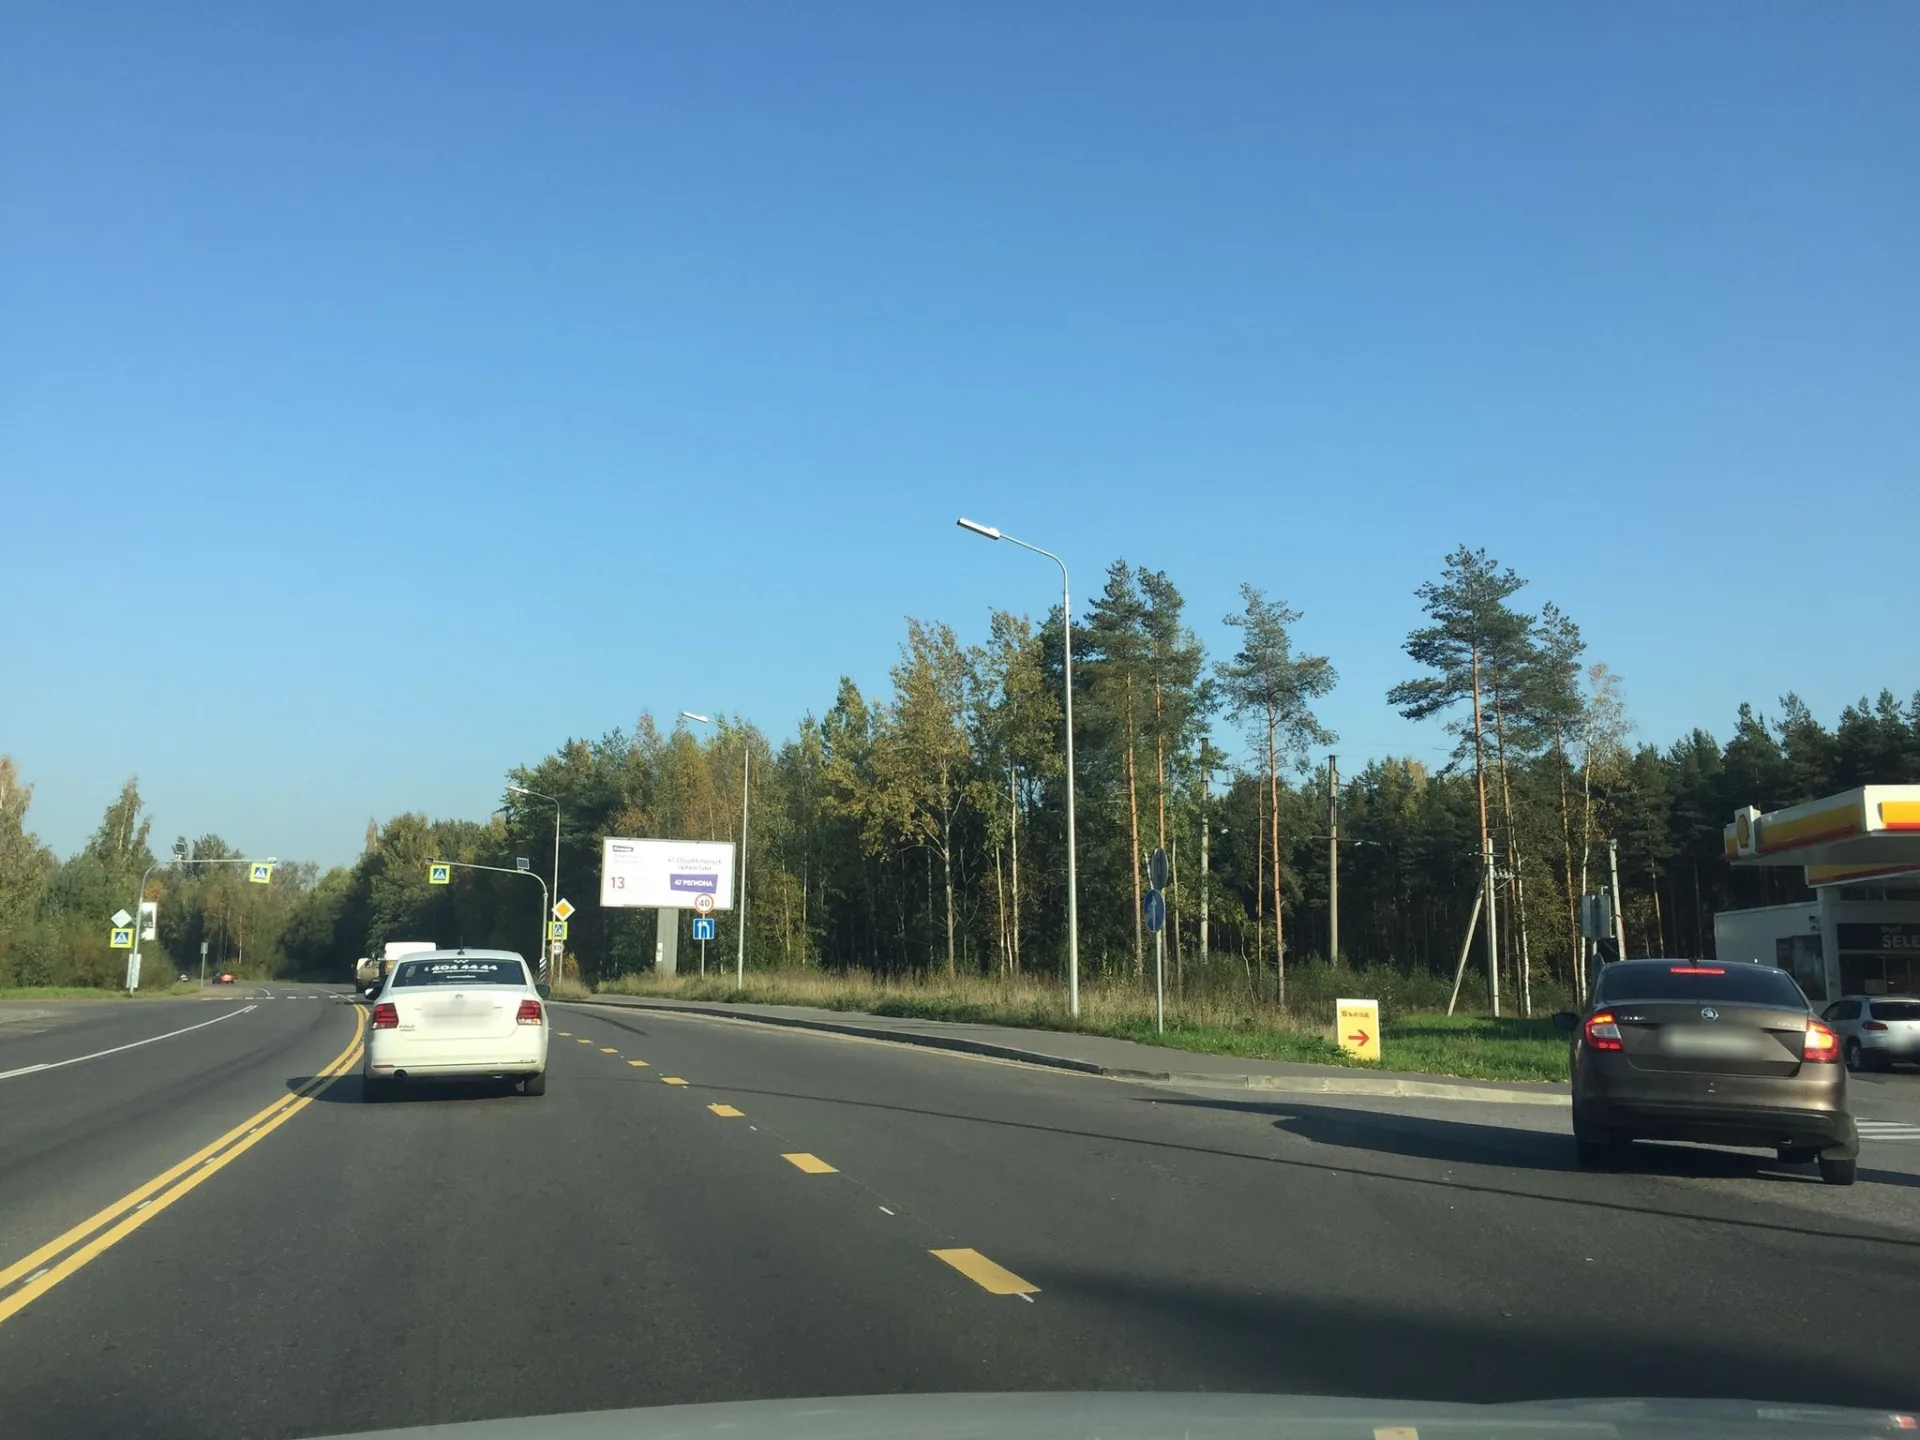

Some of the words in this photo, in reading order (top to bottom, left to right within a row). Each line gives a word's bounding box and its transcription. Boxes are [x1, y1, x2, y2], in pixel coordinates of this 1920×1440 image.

[611, 875, 625, 890] 13
[683, 879, 714, 887] РЕГИОНА
[698, 899, 710, 908] 40
[1880, 923, 1902, 934] Shell
[1341, 1010, 1370, 1018] Въезд
